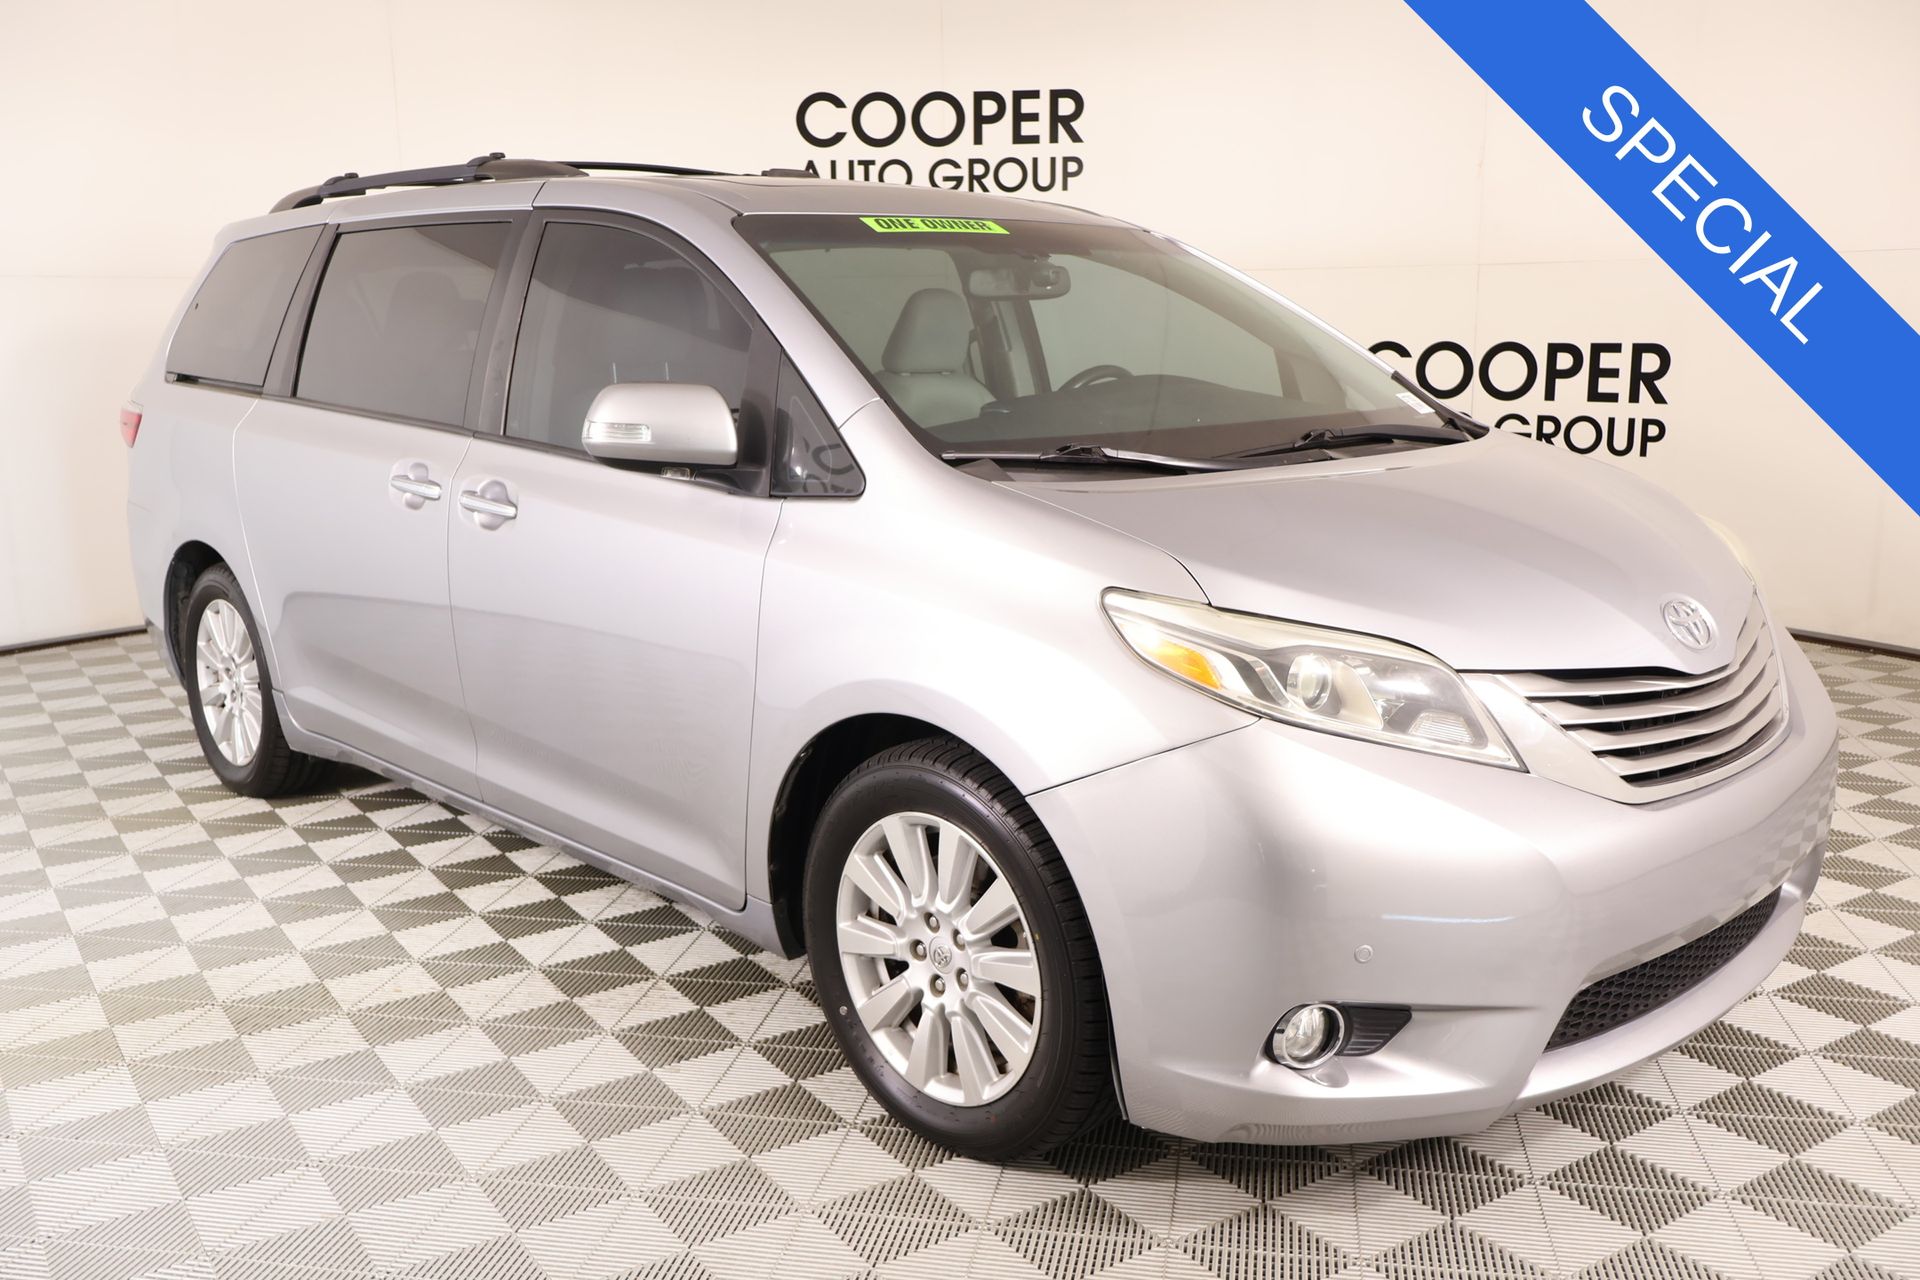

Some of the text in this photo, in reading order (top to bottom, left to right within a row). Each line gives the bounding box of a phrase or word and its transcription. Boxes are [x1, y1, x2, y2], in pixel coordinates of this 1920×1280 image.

[796, 89, 1084, 147] COOPER
[929, 156, 1083, 192] GROUP
[874, 218, 992, 231] ONE OWNER
